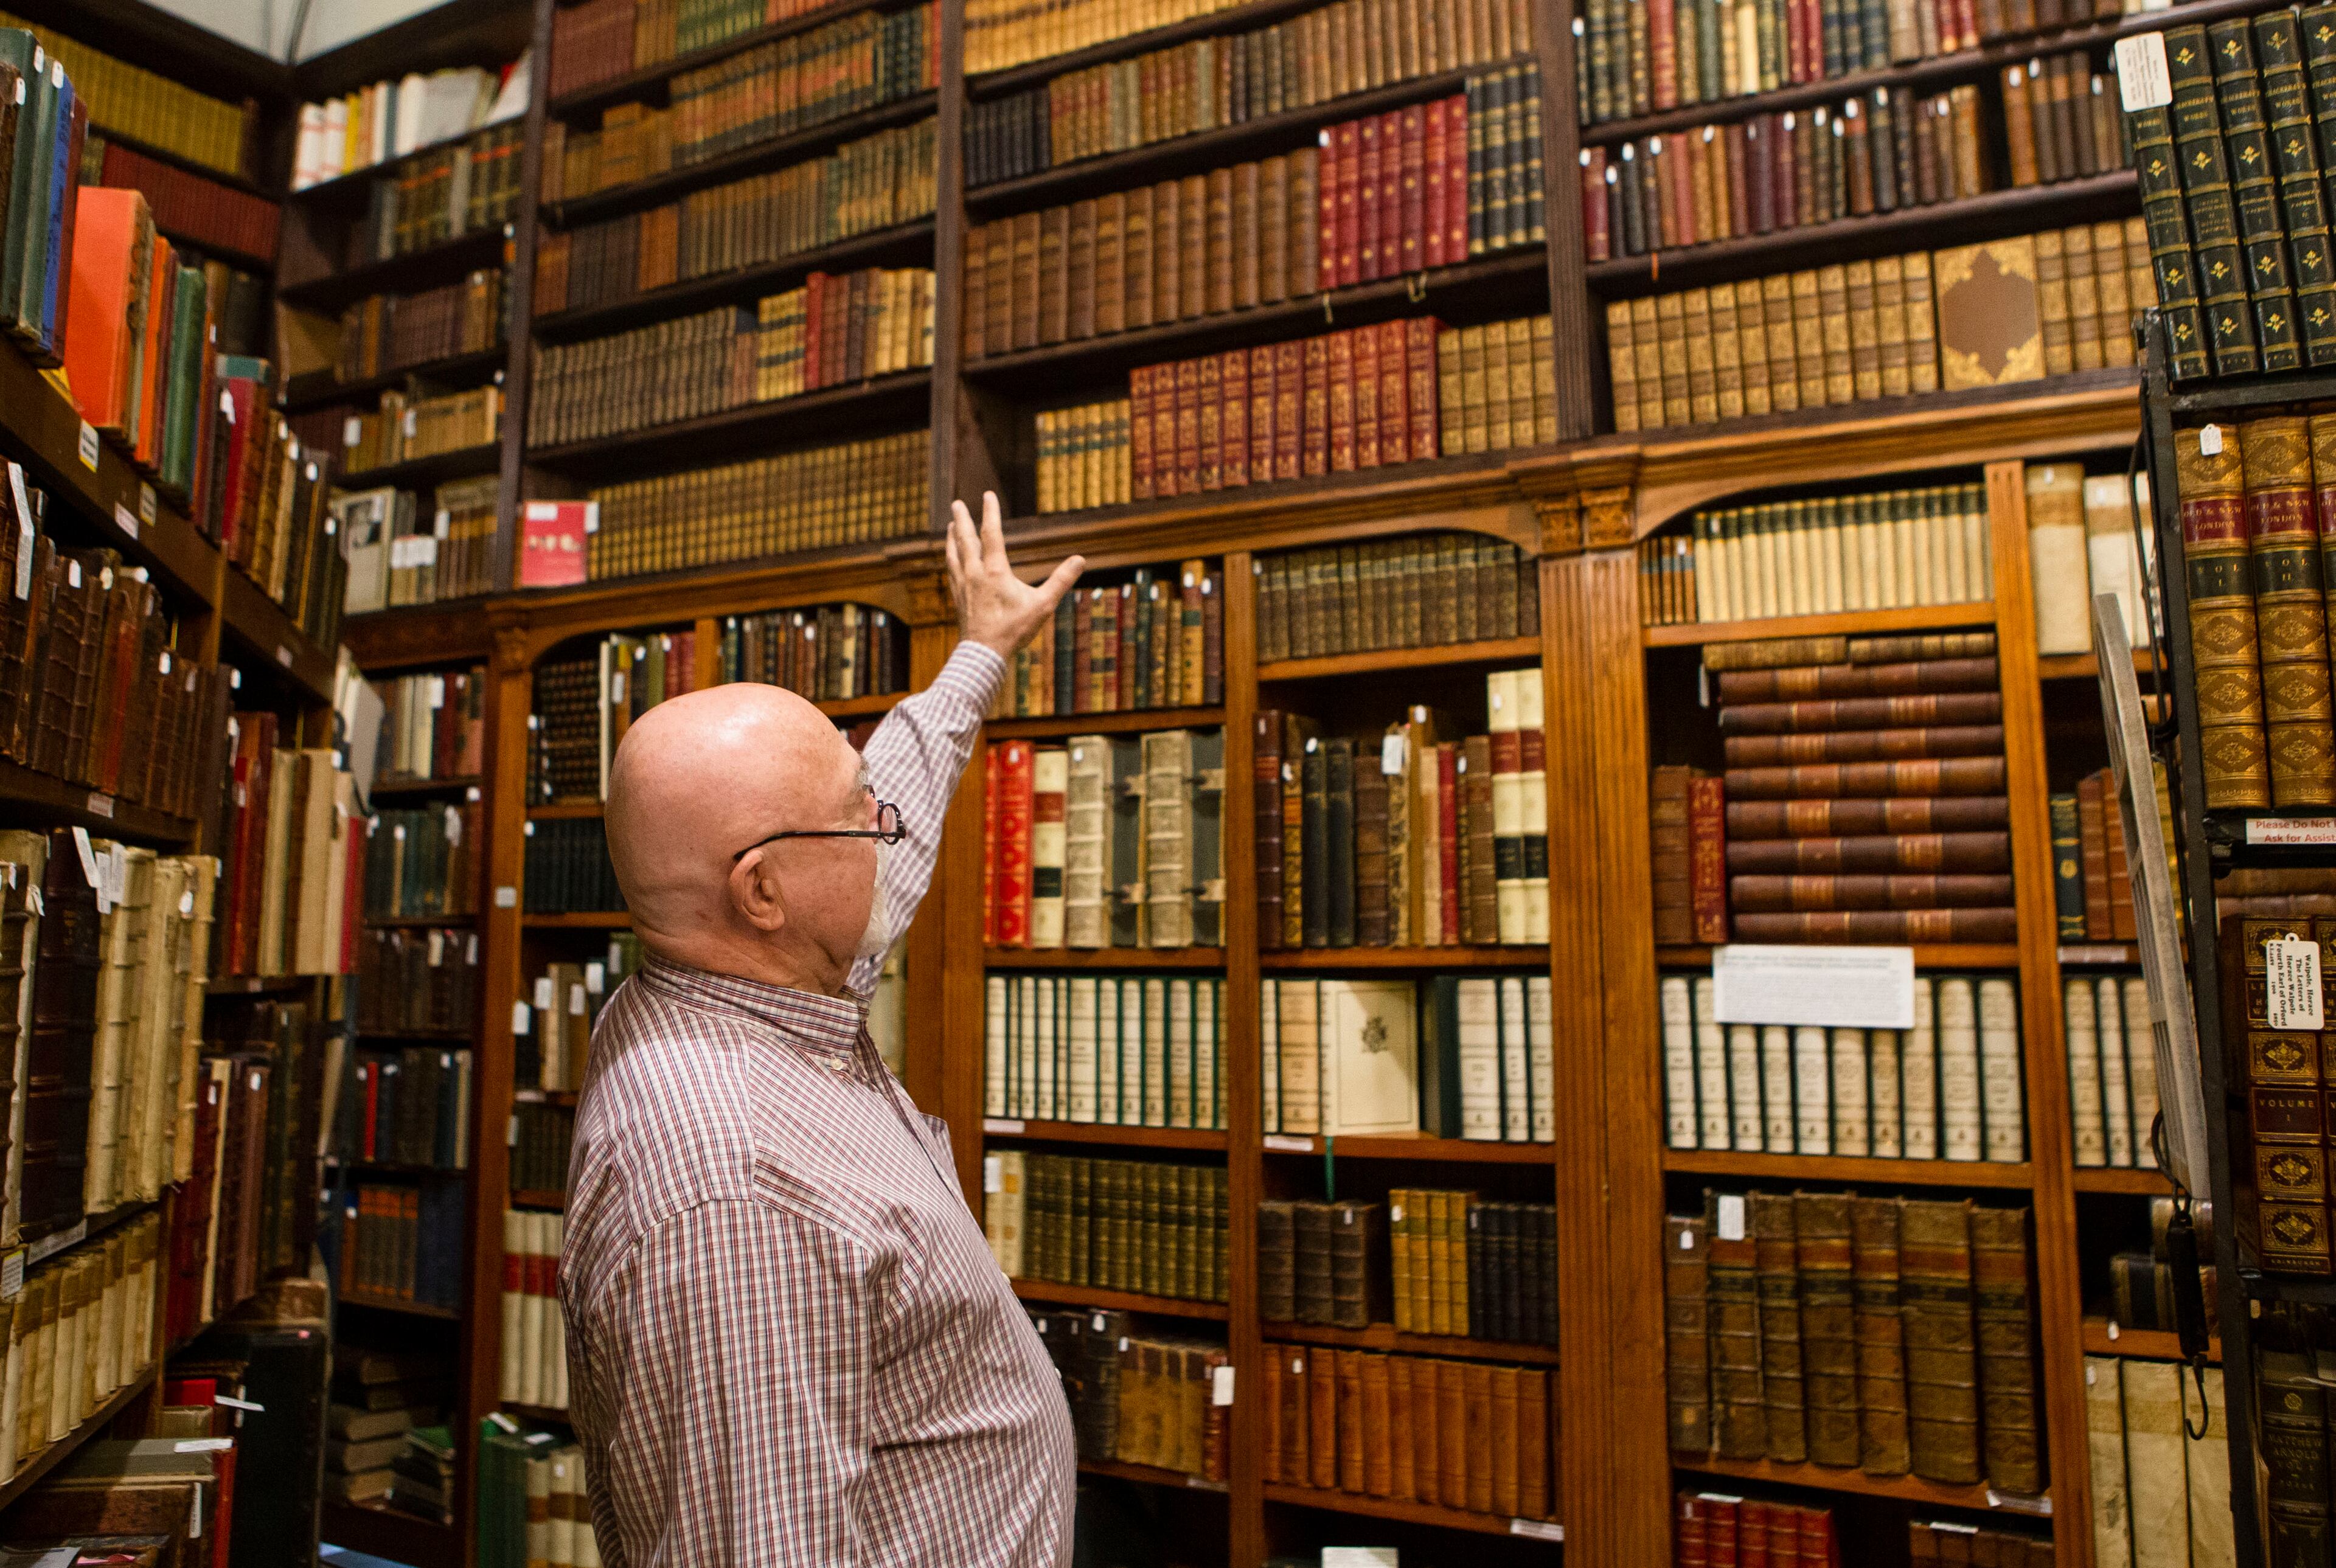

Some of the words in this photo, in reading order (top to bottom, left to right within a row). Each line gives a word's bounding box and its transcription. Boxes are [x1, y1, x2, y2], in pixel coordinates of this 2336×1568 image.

[2256, 820, 2290, 829] Please
[2264, 834, 2283, 842] Ask
[2286, 834, 2301, 842] for
[2299, 1004, 2305, 1012] of
[2259, 1099, 2314, 1108] VOLUME
